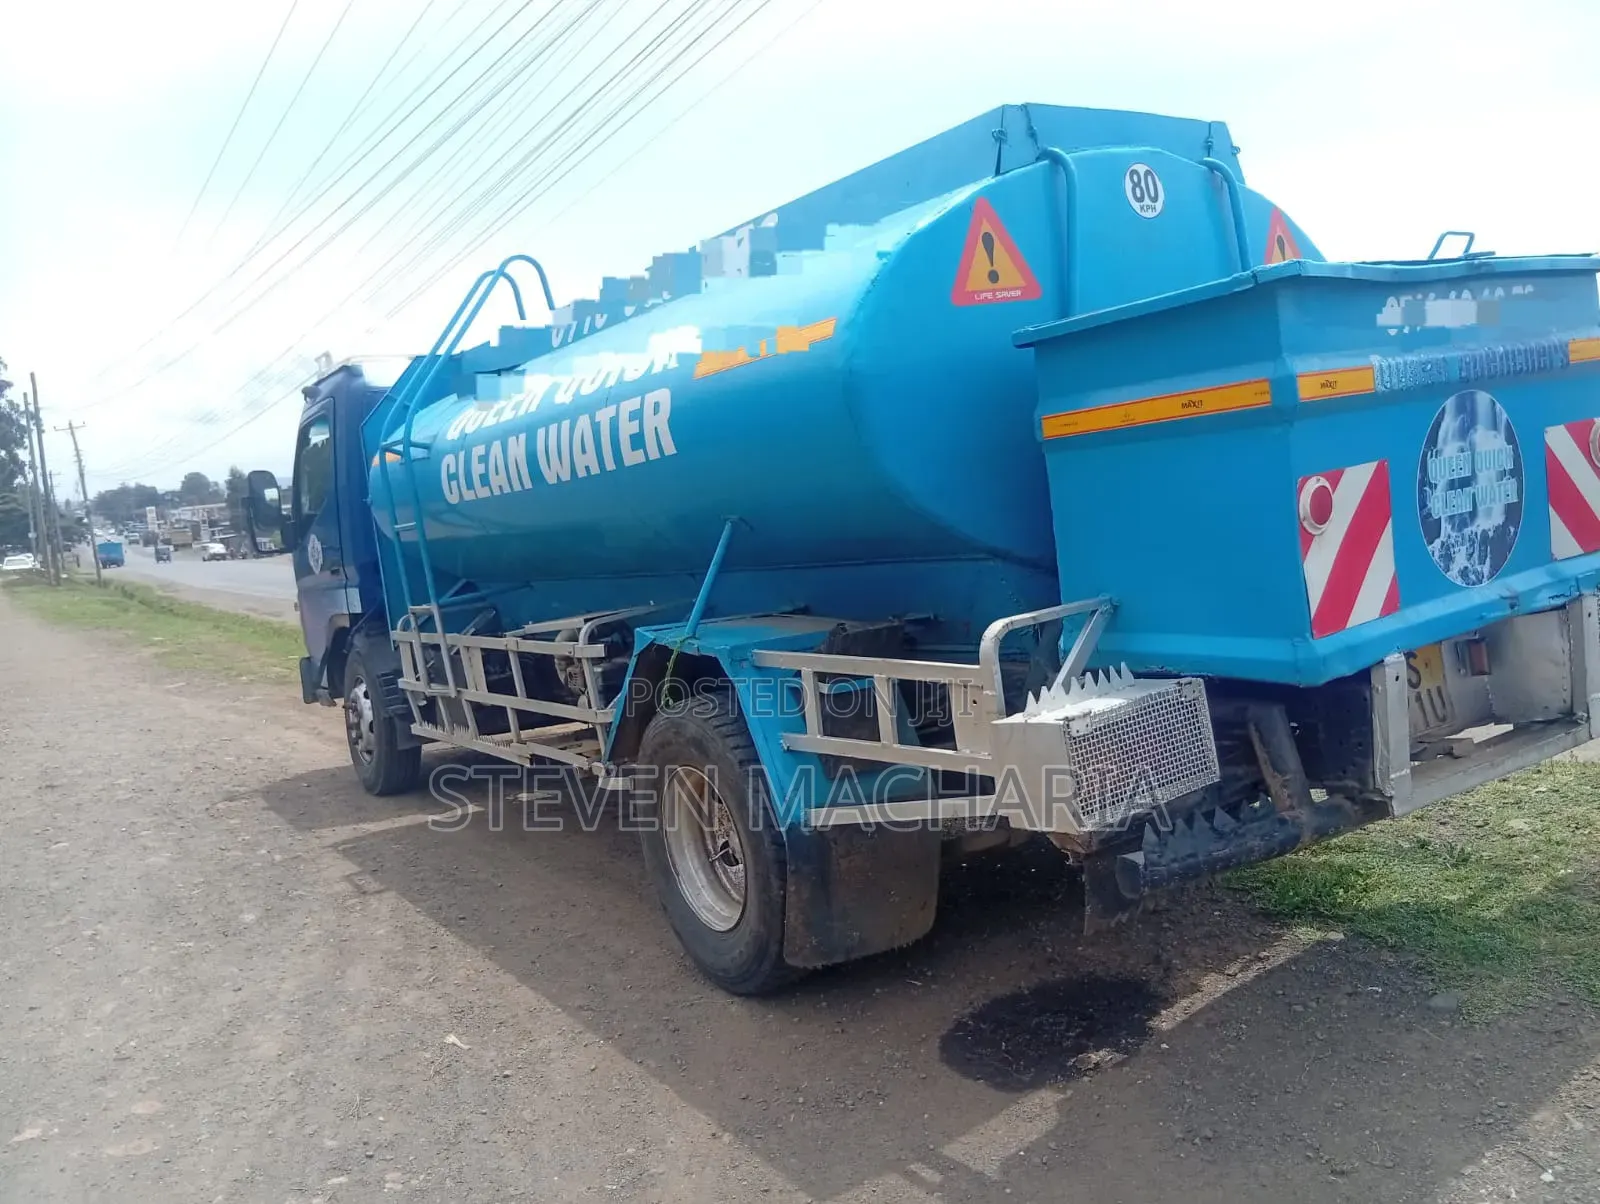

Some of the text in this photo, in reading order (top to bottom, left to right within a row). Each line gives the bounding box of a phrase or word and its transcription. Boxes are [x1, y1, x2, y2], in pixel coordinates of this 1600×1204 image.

[1129, 168, 1159, 203] 80
[1139, 204, 1157, 213] KPH
[974, 289, 1022, 300] LIFE SAVER
[440, 388, 678, 505] CLEAN WATER
[1428, 451, 1472, 484] QUEEN
[1430, 478, 1519, 519] CLEAN WATER
